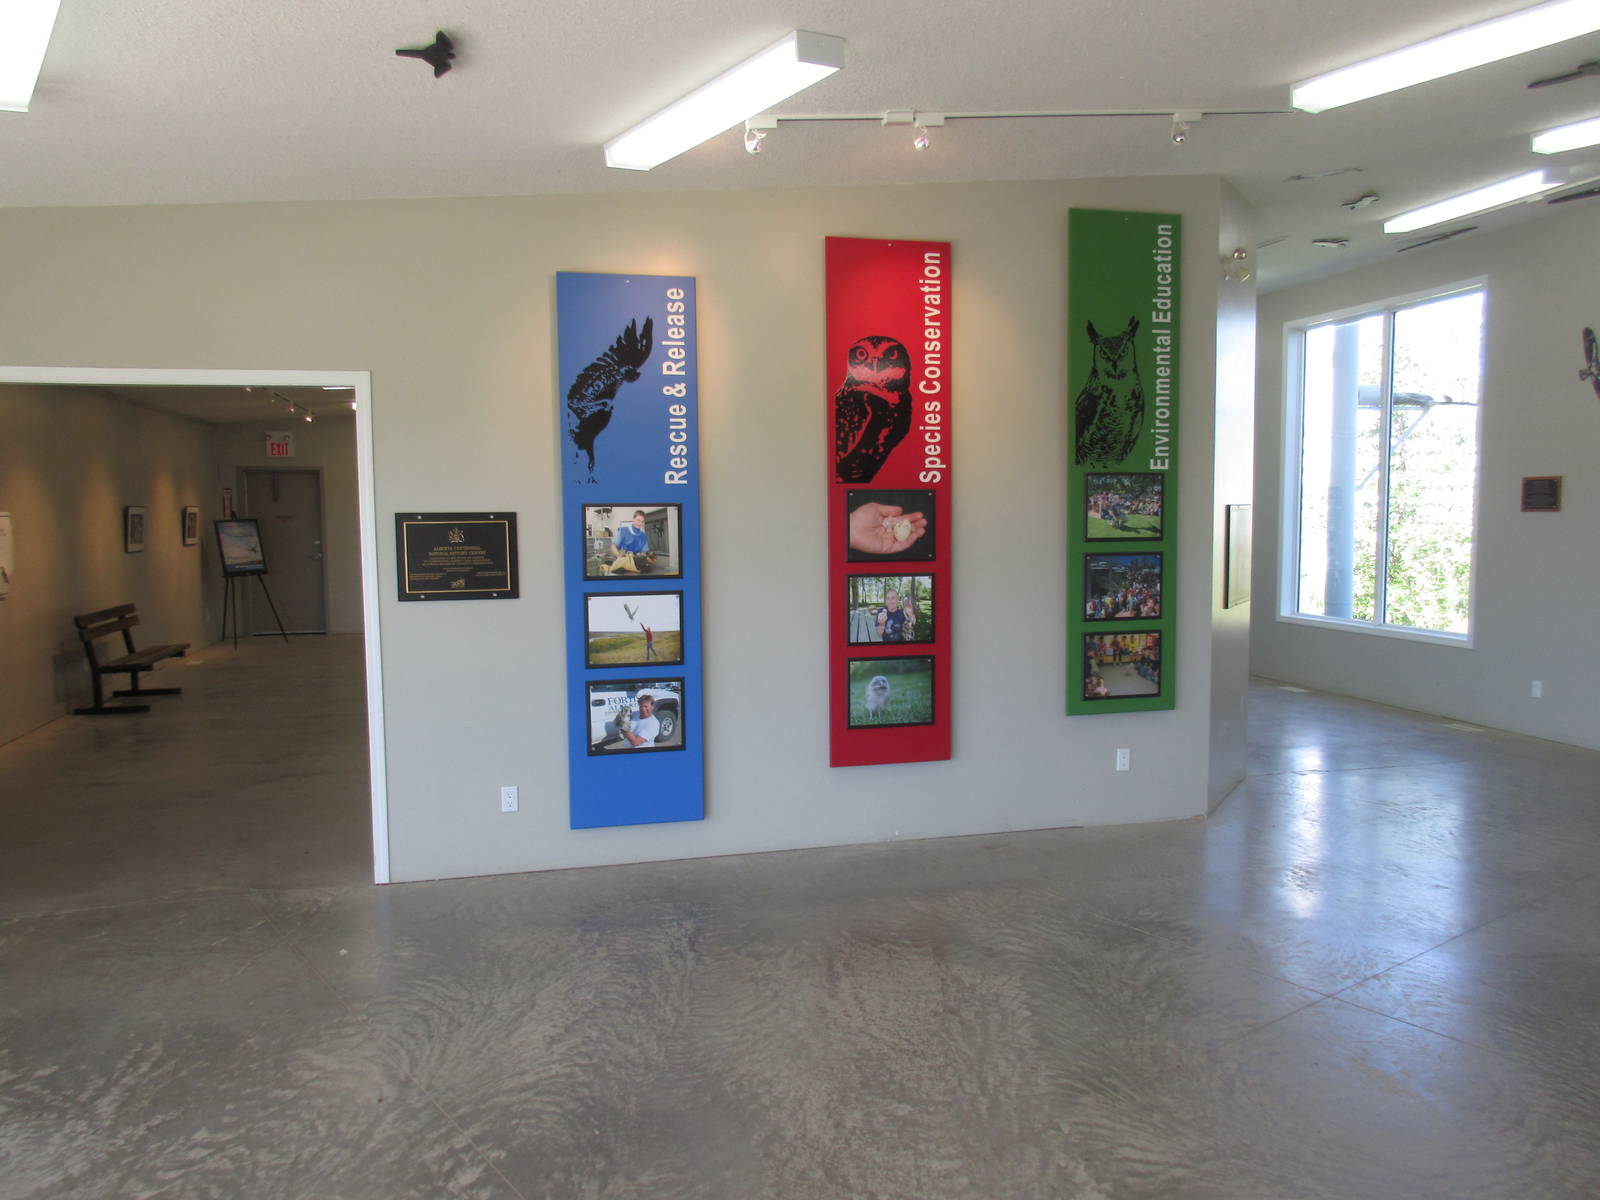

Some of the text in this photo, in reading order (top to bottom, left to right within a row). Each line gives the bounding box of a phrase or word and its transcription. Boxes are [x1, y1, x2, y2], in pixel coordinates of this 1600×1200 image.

[271, 442, 288, 455] EXIT
[662, 287, 688, 485] Rescue & Release
[919, 251, 946, 484] Species Conservation
[1150, 223, 1173, 470] Environmental Education
